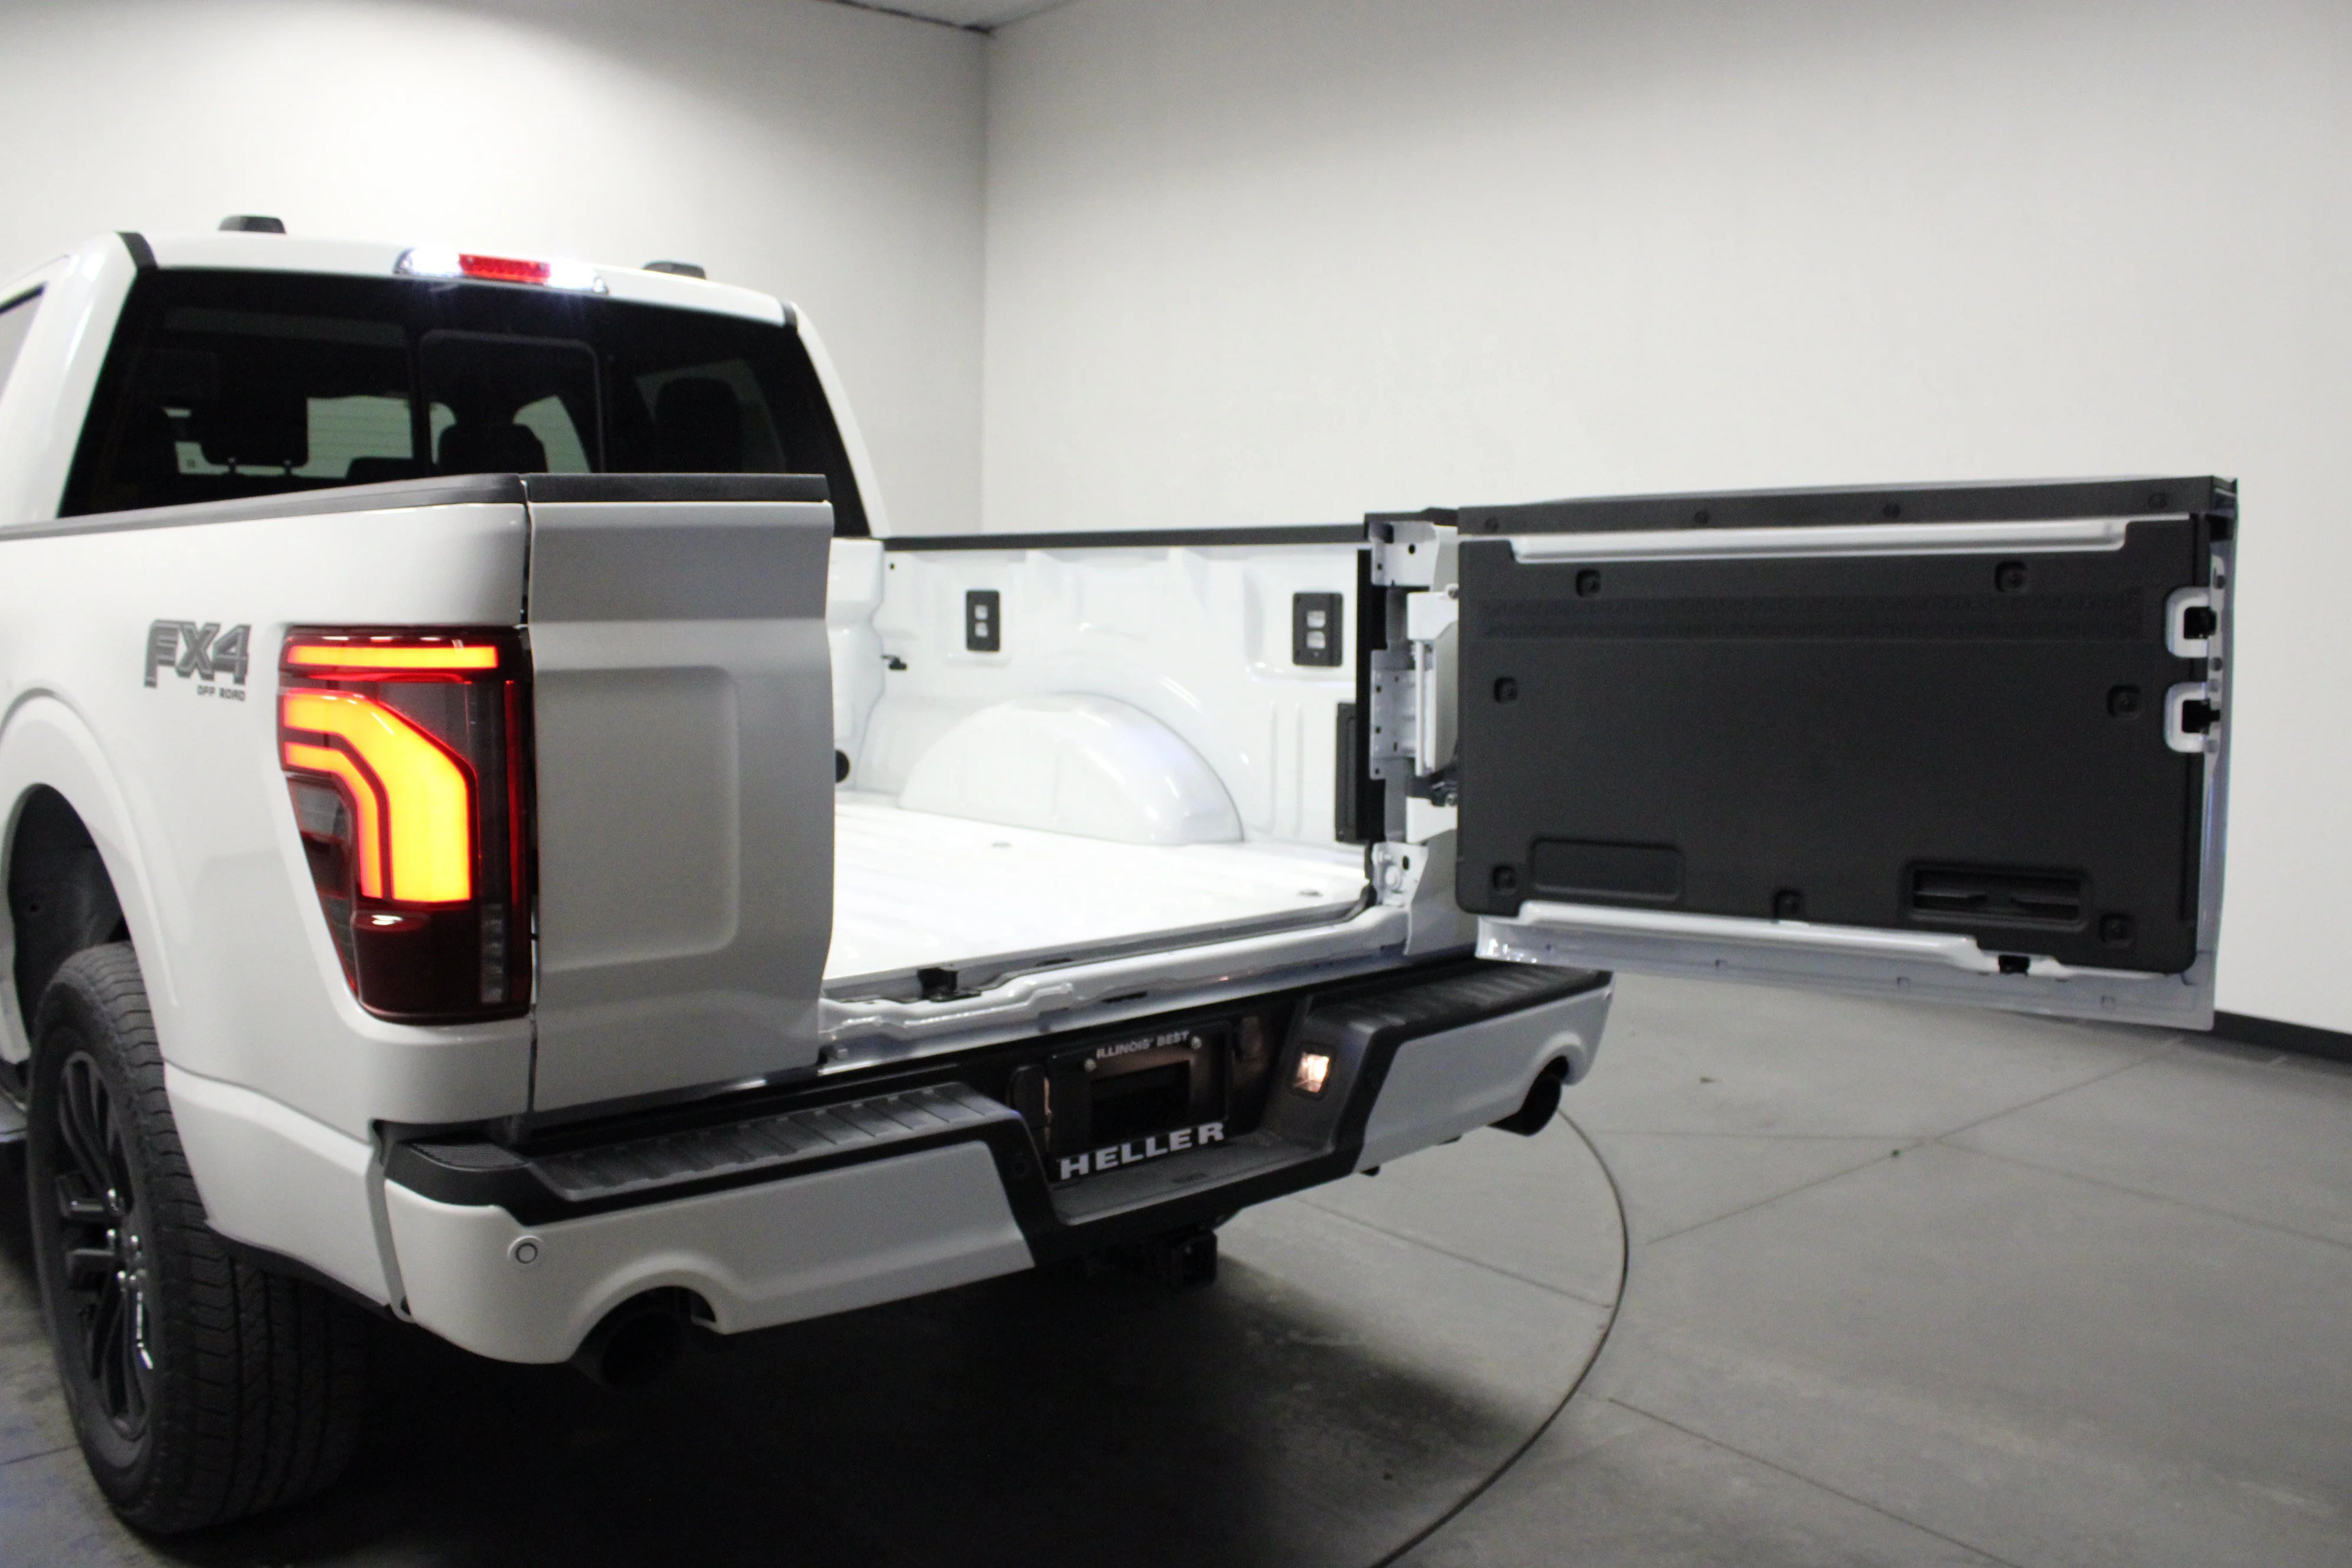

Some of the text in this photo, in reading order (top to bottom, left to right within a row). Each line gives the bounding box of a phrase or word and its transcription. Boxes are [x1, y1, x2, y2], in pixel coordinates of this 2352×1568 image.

[144, 619, 251, 688] FX4
[197, 685, 246, 701] OFF ROAD
[1157, 1030, 1190, 1047] BEST
[1060, 1122, 1225, 1180] HELLER
